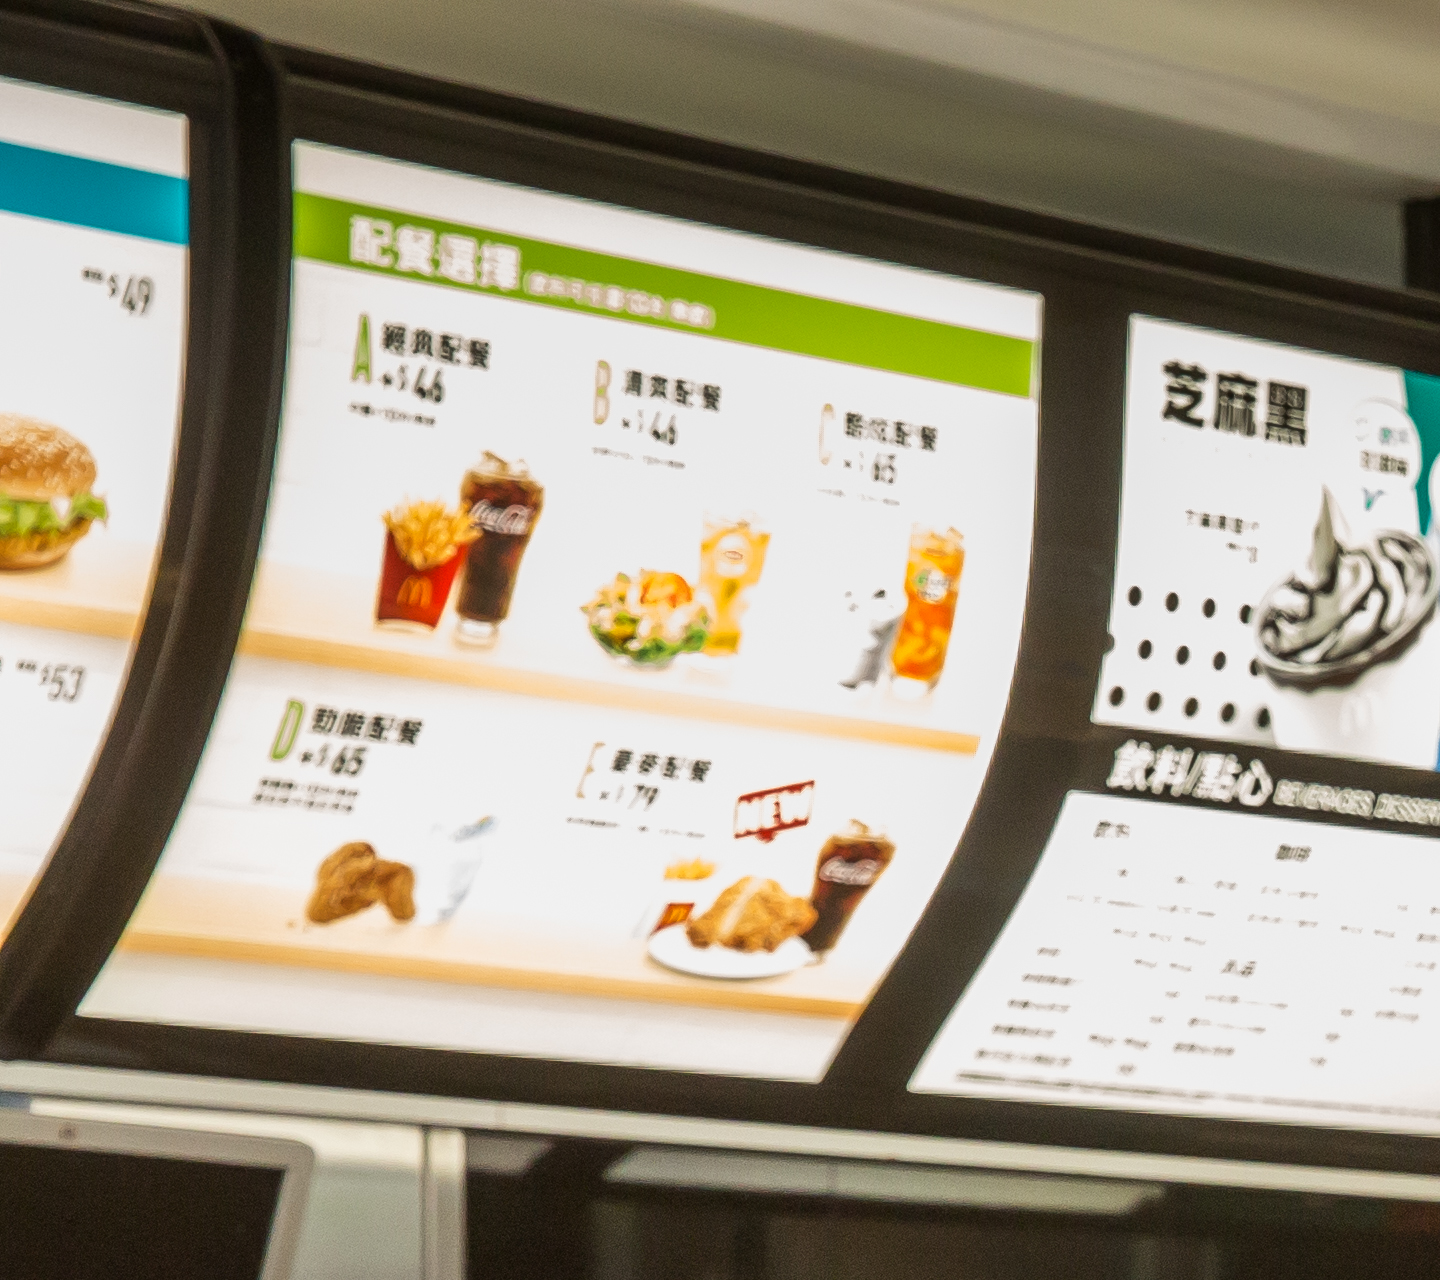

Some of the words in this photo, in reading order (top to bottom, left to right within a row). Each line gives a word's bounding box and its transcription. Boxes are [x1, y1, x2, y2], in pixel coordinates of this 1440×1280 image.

[349, 214, 522, 291] 配餐選擇
[352, 312, 371, 384] A
[381, 322, 491, 369] 經典配餐
[1161, 359, 1309, 447] 芝麻黑
[1106, 738, 1273, 807] 飲料/點心
